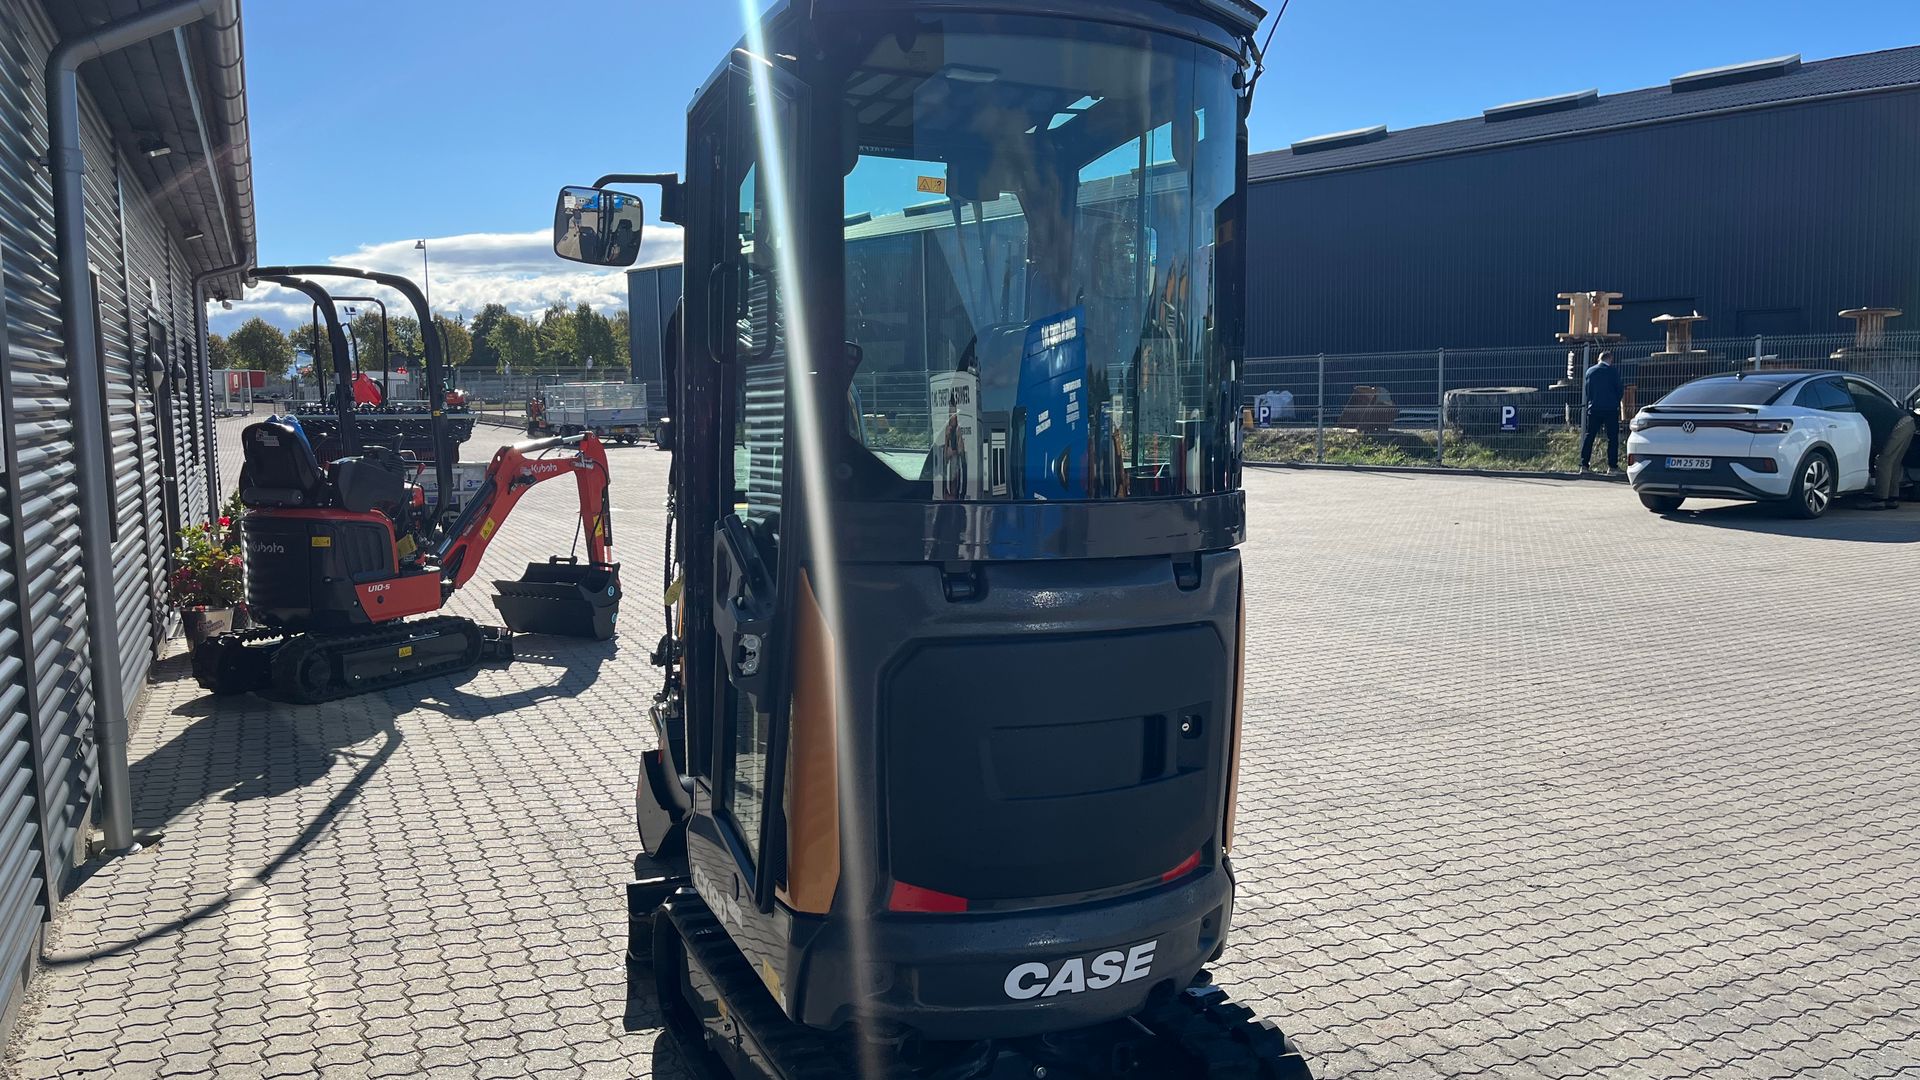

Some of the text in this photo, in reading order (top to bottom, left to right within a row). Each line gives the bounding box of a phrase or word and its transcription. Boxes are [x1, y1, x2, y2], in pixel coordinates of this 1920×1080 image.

[1260, 407, 1270, 422] P
[1501, 406, 1515, 424] P
[531, 463, 557, 473] Kubota
[1670, 459, 1710, 468] DM 25 785
[1004, 940, 1158, 1000] CASE
